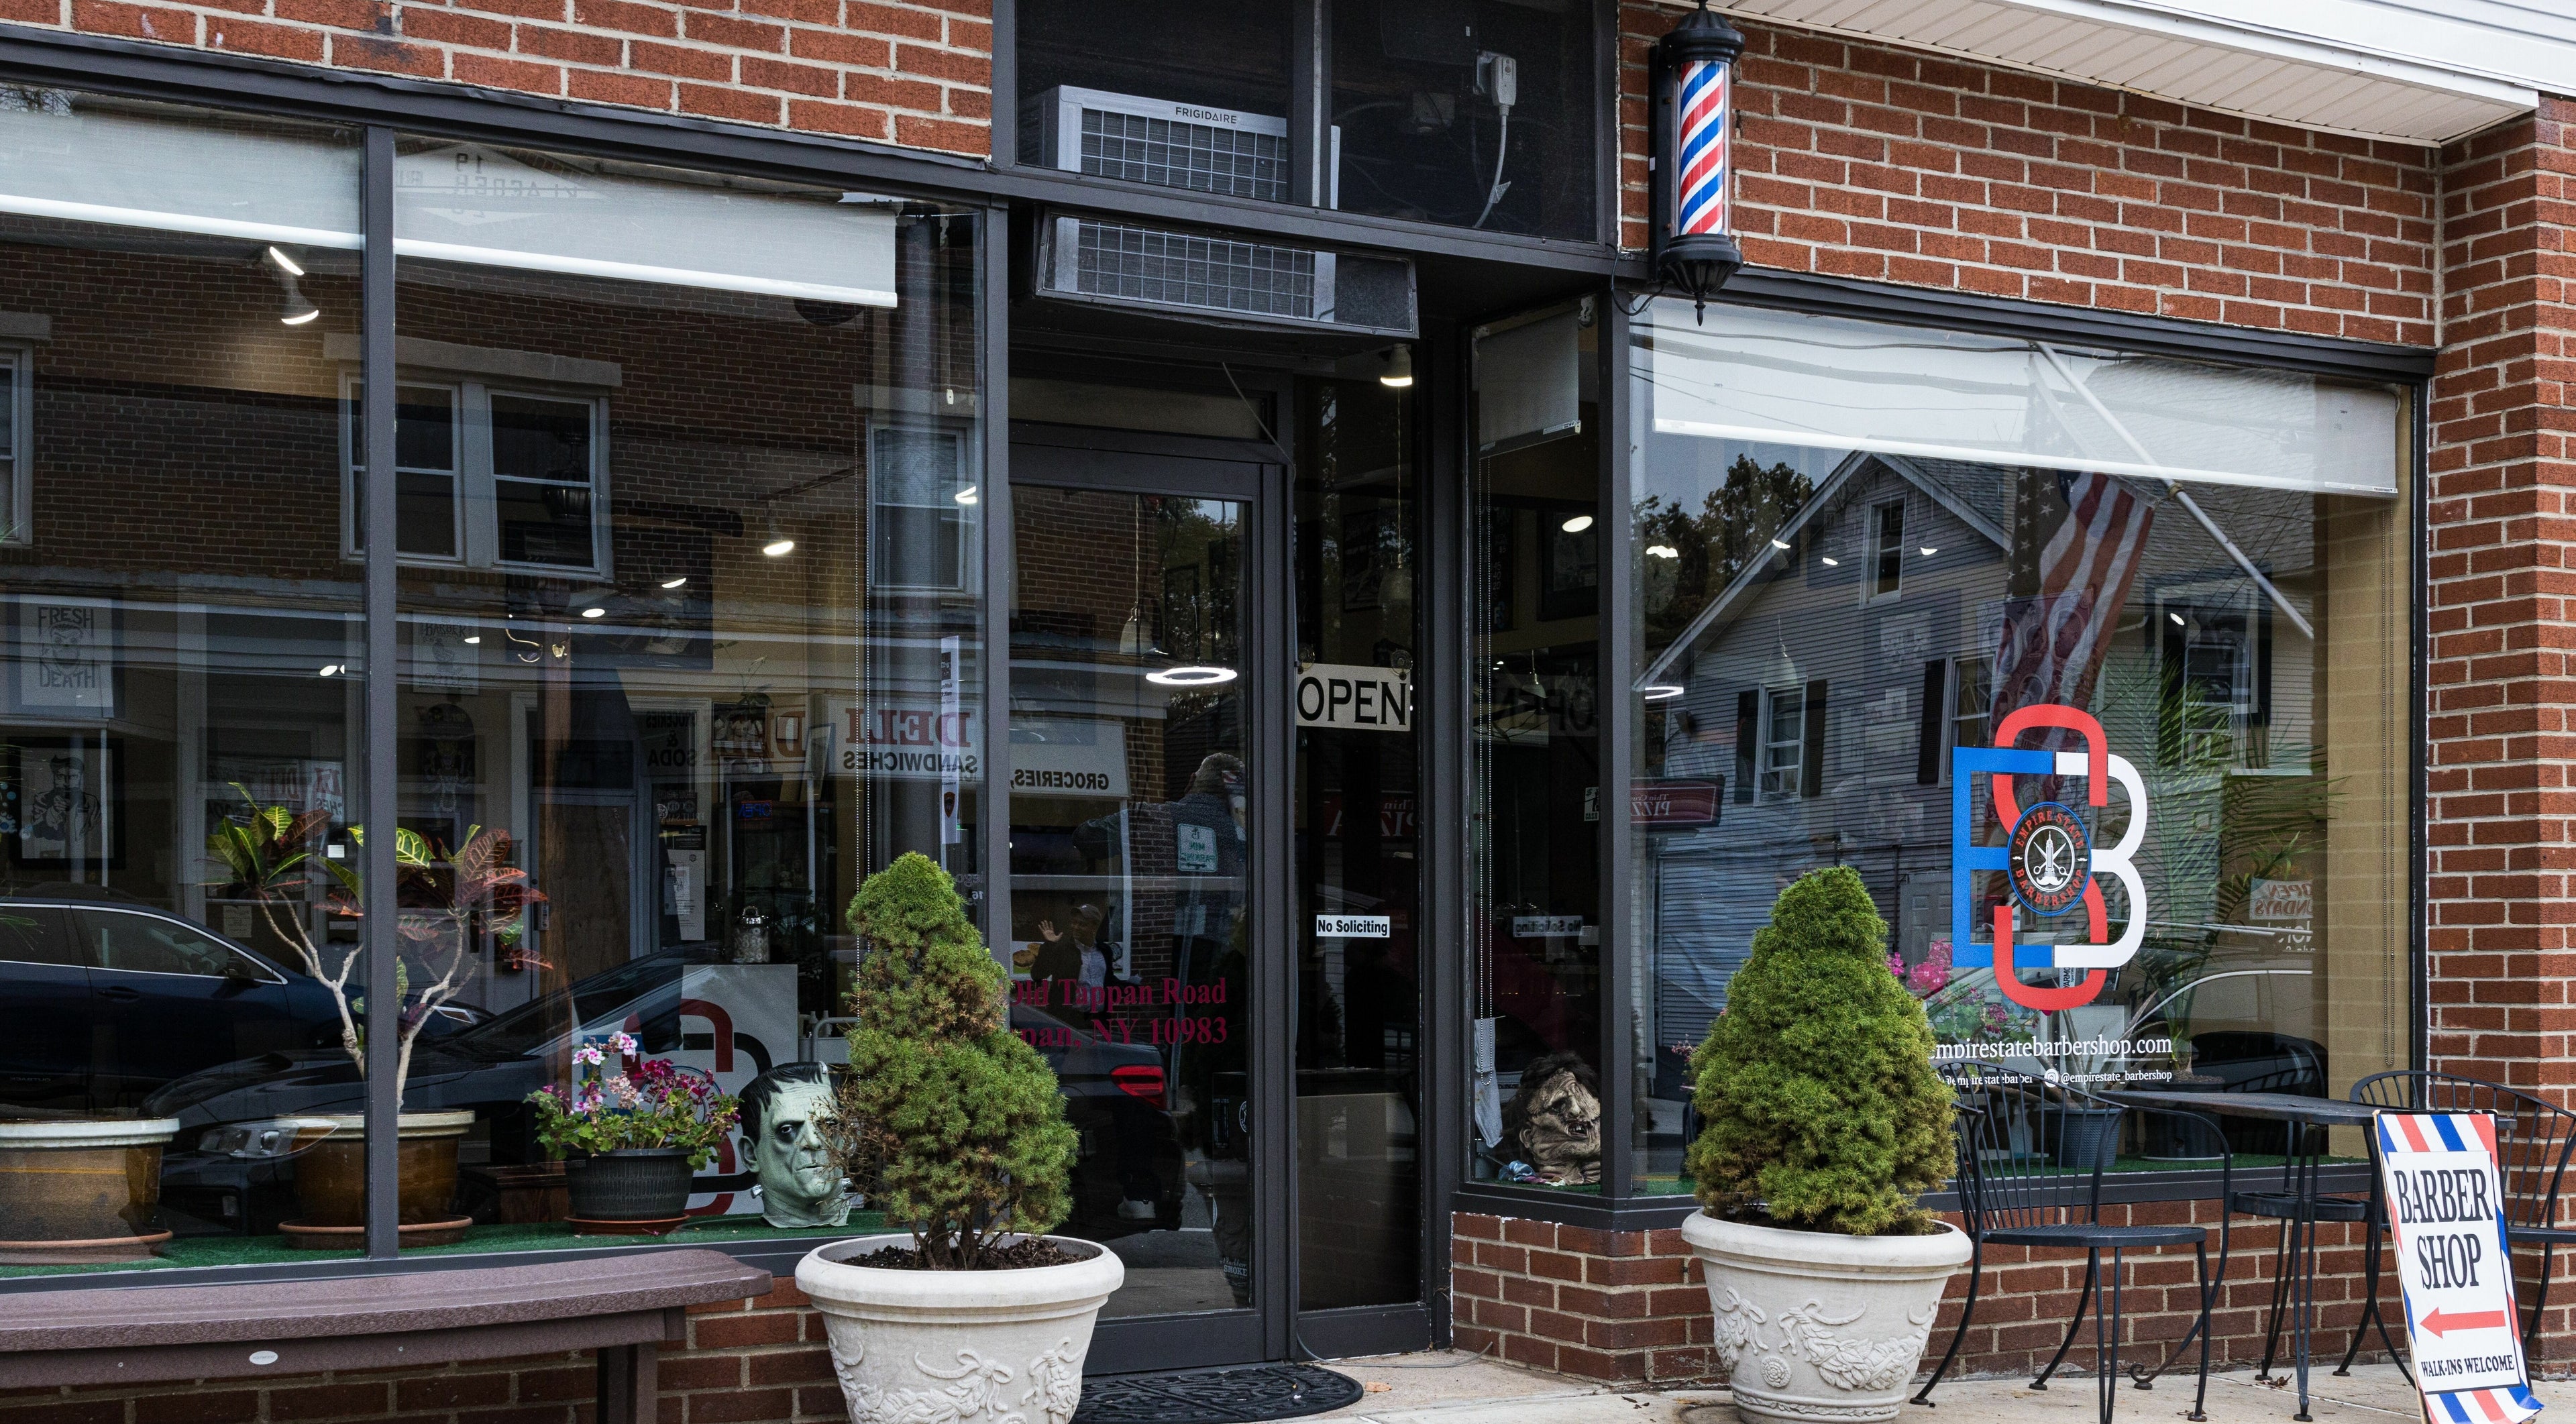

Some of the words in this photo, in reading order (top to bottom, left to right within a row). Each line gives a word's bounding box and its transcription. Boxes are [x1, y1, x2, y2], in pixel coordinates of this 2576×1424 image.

[1176, 107, 1237, 123] FRIGIDAIRE
[38, 606, 95, 639] FRESH
[40, 660, 95, 689] DEATH
[1297, 676, 1407, 726] OPEN
[2016, 810, 2053, 848] EMPIRE
[2055, 812, 2085, 849] STATE
[2015, 867, 2085, 907] BARBERSHOP
[1318, 920, 1333, 933] No
[1336, 920, 1388, 936] Soliciting
[1058, 978, 1153, 1014] Tappan
[1162, 977, 1227, 1004] Road
[1091, 1018, 1138, 1046] NY
[1150, 1016, 1228, 1045] 10983
[2061, 1070, 2173, 1085] @empirestate_barbershop
[2394, 1168, 2493, 1224] BARBER
[1224, 1264, 1248, 1276] SMOKE
[2417, 1234, 2482, 1291] SHOP
[2421, 1358, 2463, 1378] WALK-INS
[2465, 1354, 2515, 1374] WELCOME
